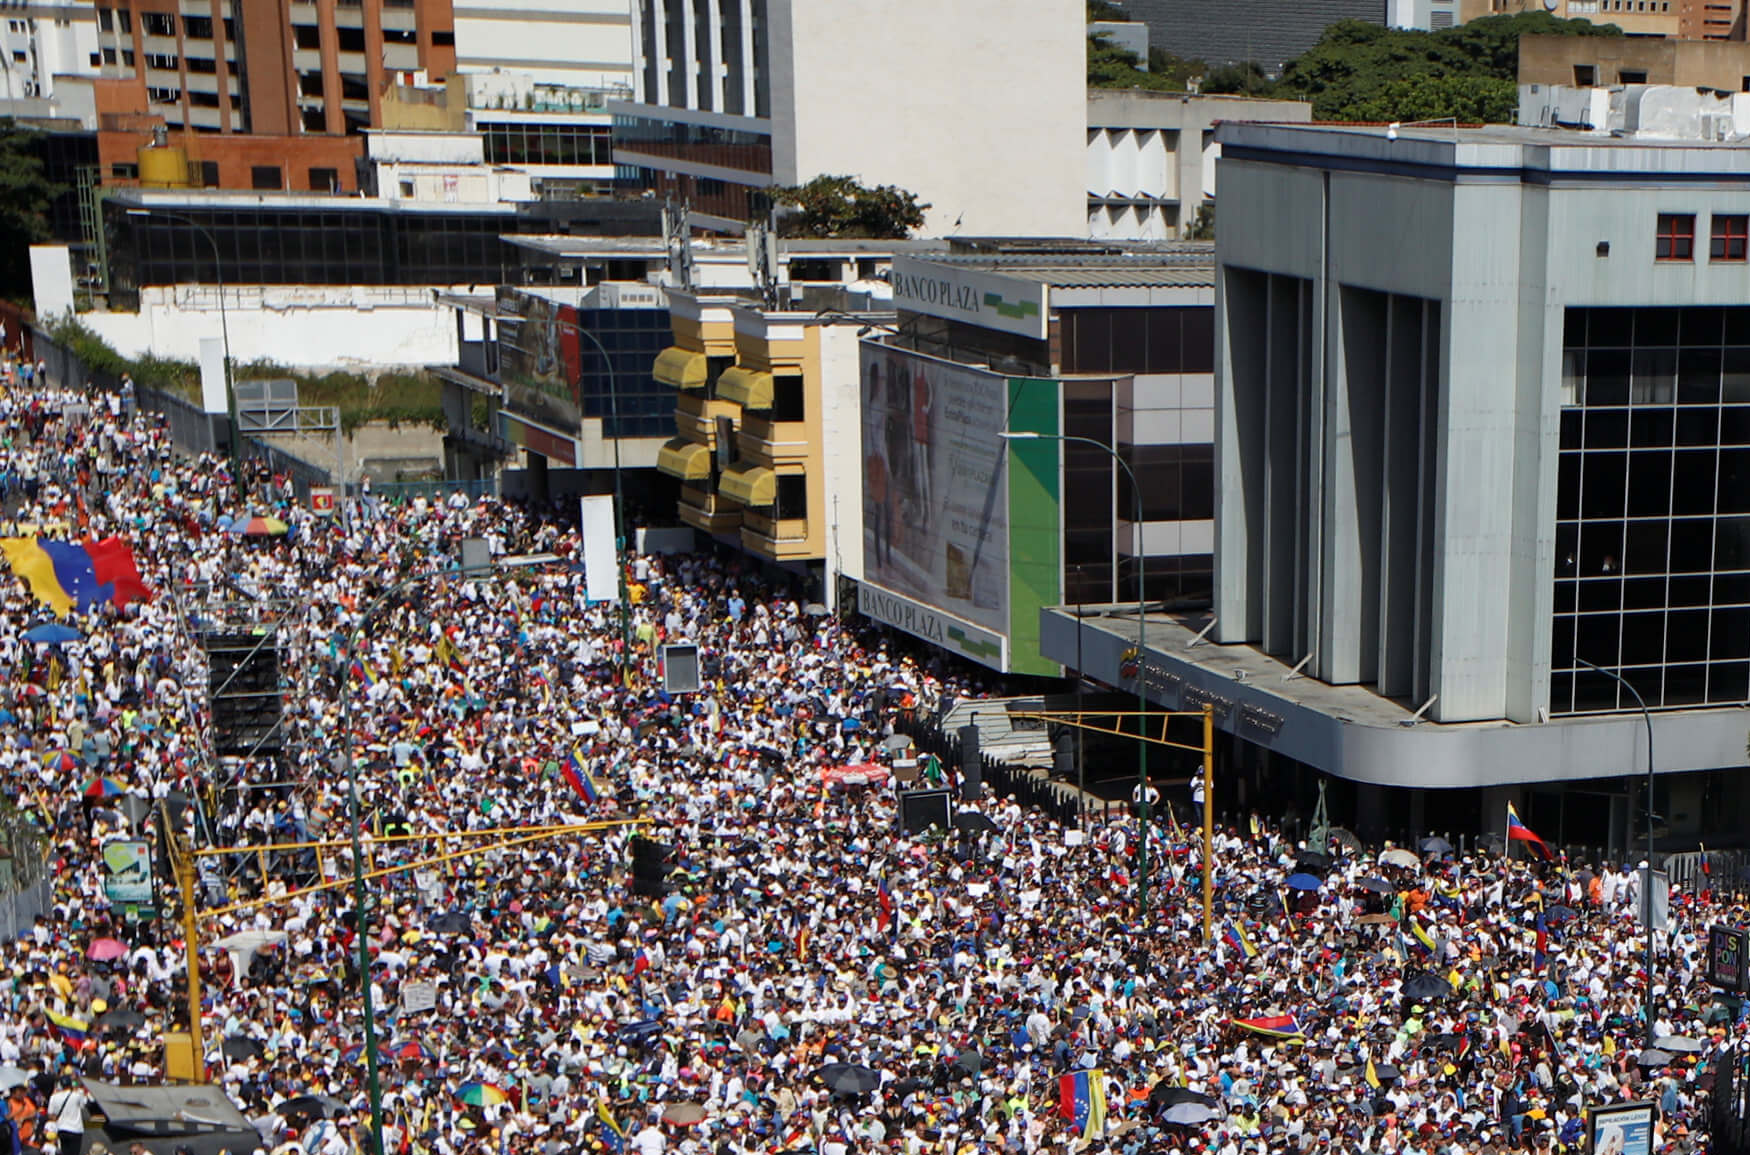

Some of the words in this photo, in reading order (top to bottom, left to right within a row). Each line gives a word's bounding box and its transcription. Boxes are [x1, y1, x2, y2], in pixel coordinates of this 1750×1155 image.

[895, 272, 937, 305] BANCO
[939, 281, 980, 313] PLAZA
[863, 589, 903, 625] BANCO
[904, 606, 944, 643] PLAZA
